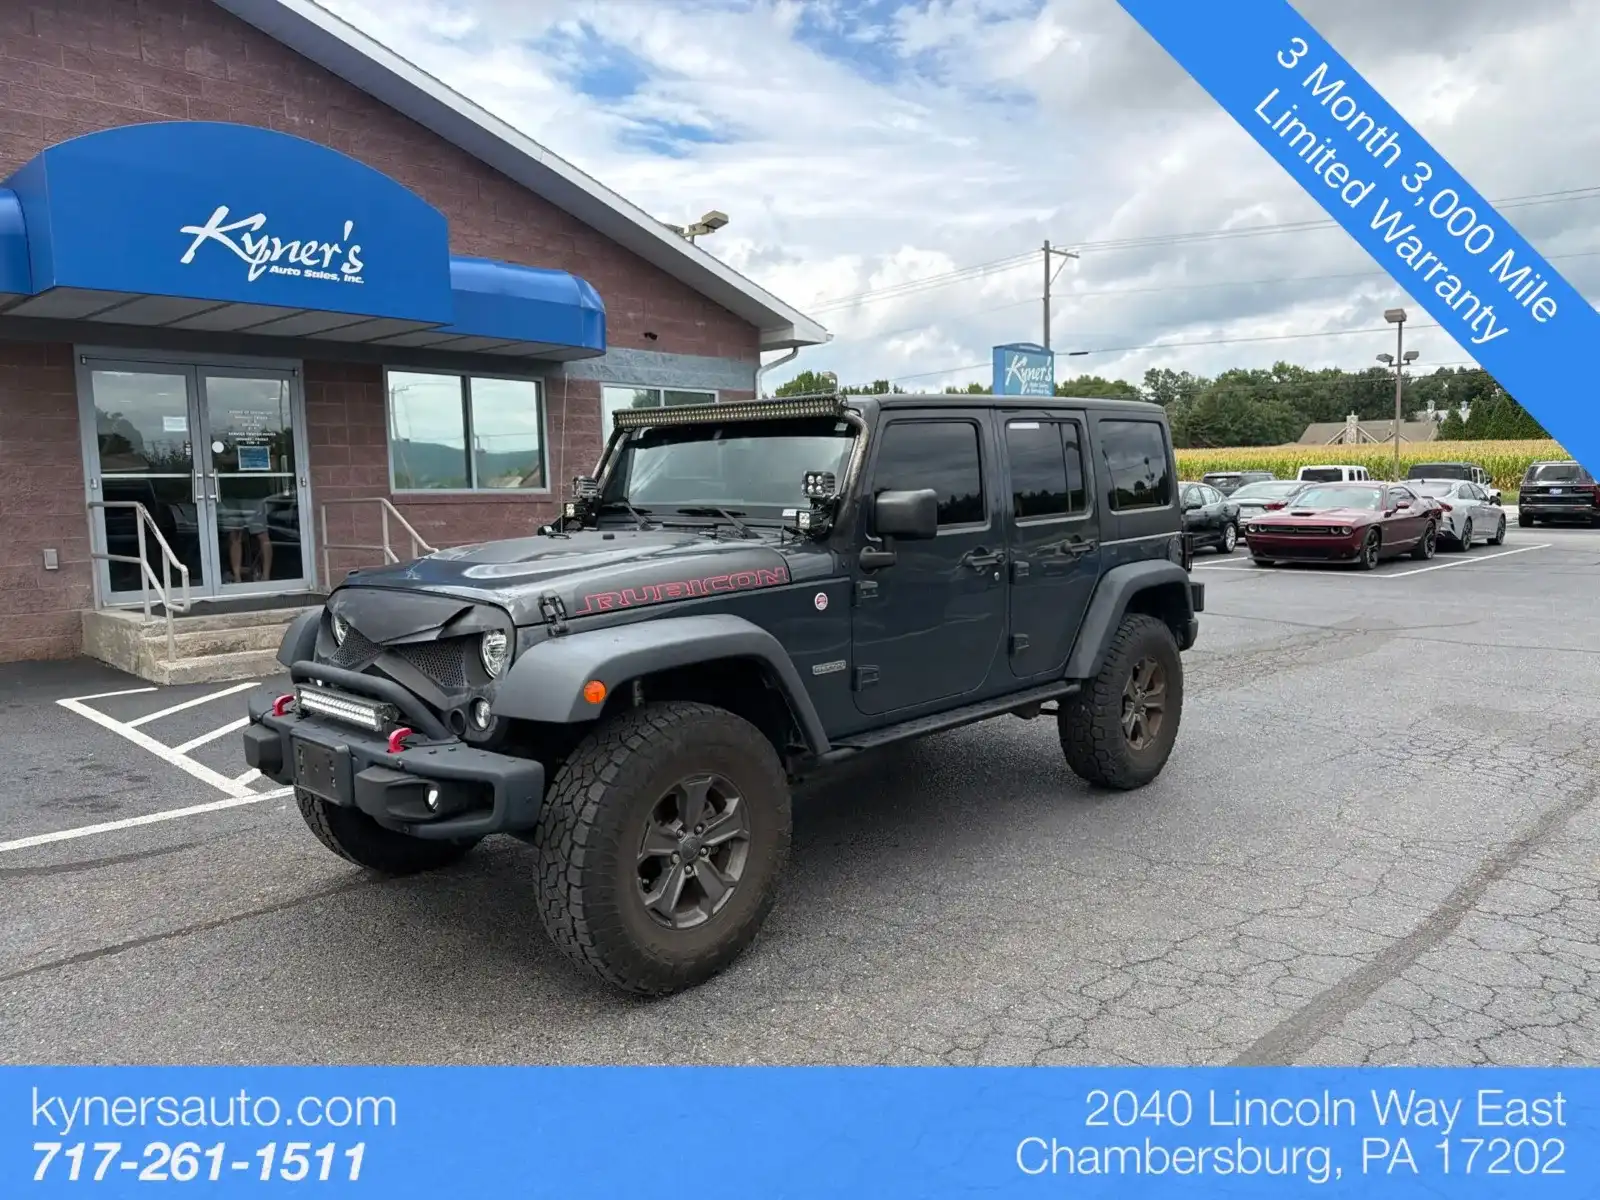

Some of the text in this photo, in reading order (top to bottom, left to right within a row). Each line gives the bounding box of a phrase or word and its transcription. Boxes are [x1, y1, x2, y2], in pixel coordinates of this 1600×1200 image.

[180, 205, 364, 282] Kyner's
[269, 265, 301, 276] Auto
[304, 269, 340, 282] Sales,
[1005, 354, 1052, 394] Kyner's
[576, 566, 790, 614] RUBICON
